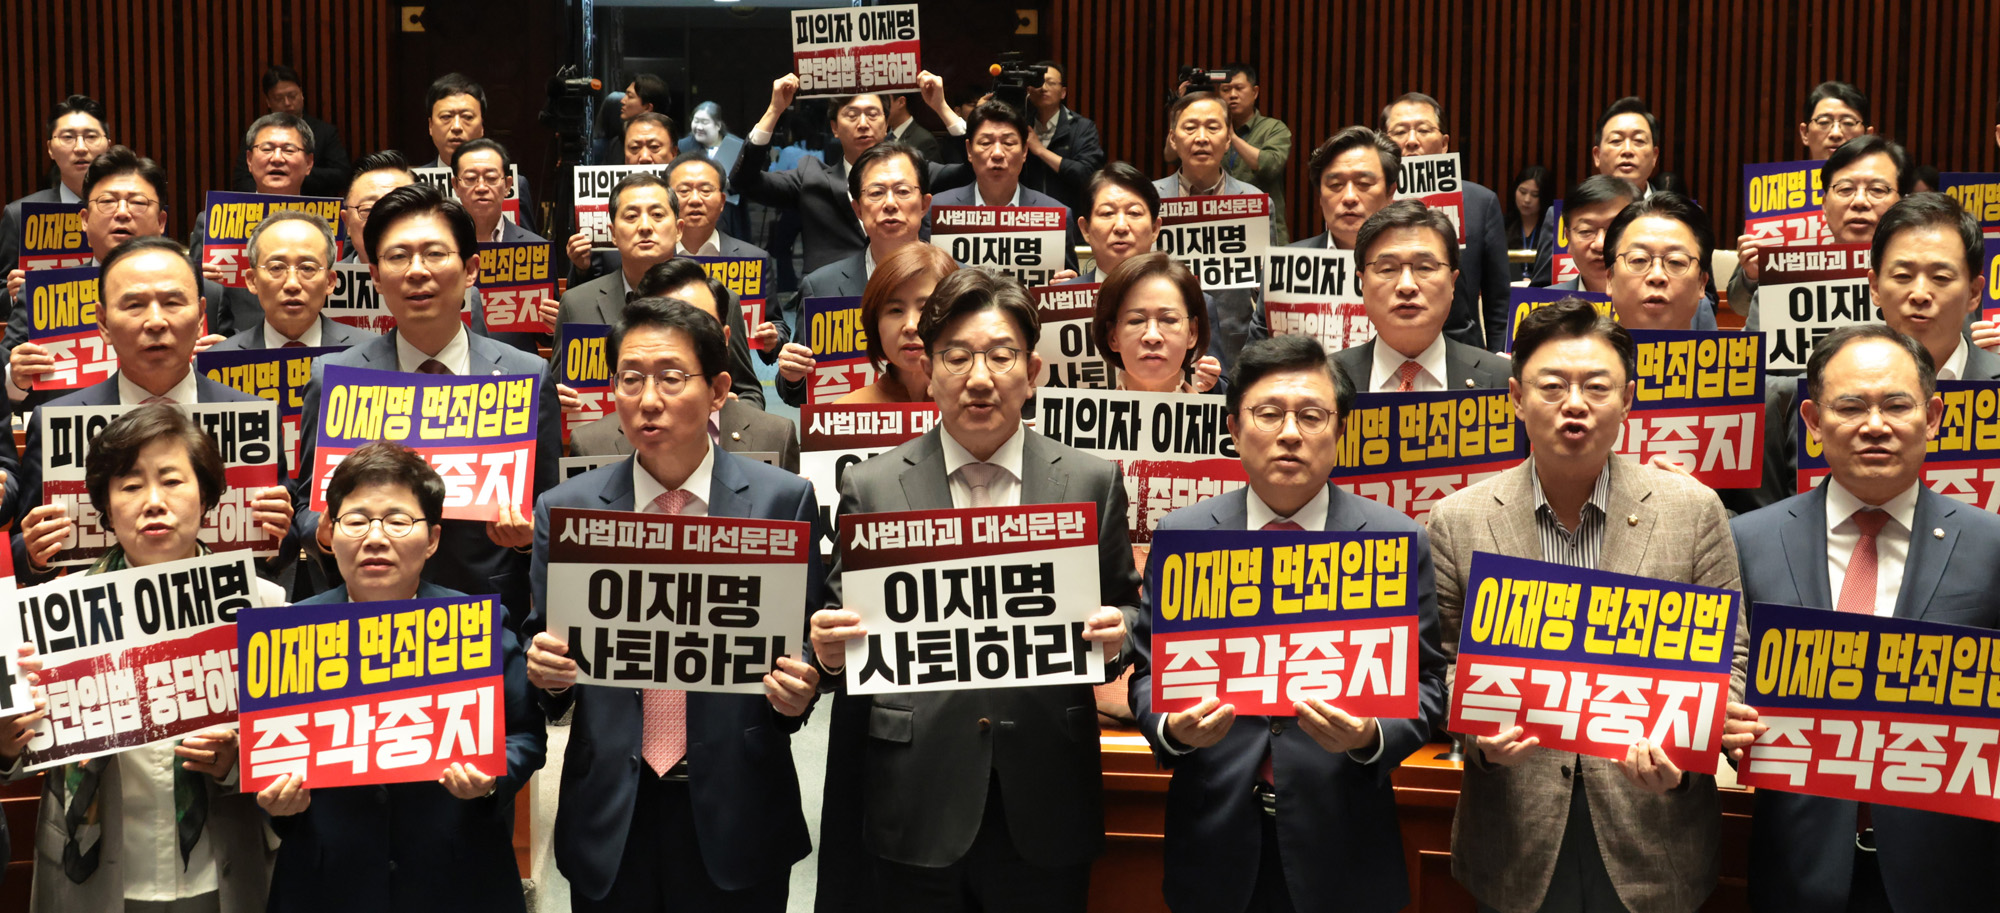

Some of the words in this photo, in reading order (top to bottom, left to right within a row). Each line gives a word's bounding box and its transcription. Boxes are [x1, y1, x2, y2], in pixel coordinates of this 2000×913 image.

[796, 13, 853, 44] 피의자
[859, 9, 915, 41] 이재명
[798, 55, 856, 90] 방탄입법
[860, 52, 917, 86] 중단하라
[1397, 158, 1457, 194] 이재명
[1749, 170, 1806, 213] 이재명
[208, 202, 264, 239] 이재명
[936, 210, 996, 227] 사법파괴
[1001, 211, 1060, 228] 대선문란
[1202, 198, 1263, 216] 대선문란
[24, 213, 83, 250] 이재명
[952, 237, 1042, 266] 이재명
[1156, 224, 1247, 256] 이재명
[479, 244, 550, 284] 면죄입법
[1270, 255, 1346, 296] 피의자
[1765, 250, 1847, 272] 사법파괴
[33, 278, 99, 331] 이재명
[480, 288, 549, 326] 중지
[1788, 284, 1886, 322] 이재
[1637, 336, 1758, 401] 면죄입법
[325, 384, 416, 440] 이재명
[420, 378, 534, 440] 면죄입법
[809, 411, 903, 435] 사법파괴
[1043, 397, 1141, 451] 피의자
[1398, 393, 1516, 463] 면죄입법
[560, 518, 674, 550] 사법파괴
[683, 524, 798, 556] 대선문란
[851, 517, 963, 550] 사법파괴
[972, 511, 1085, 543] 대선문란
[134, 560, 253, 635] 이재명
[588, 569, 761, 628] 이재명
[884, 562, 1056, 623] 이재명
[1160, 547, 1263, 621] 이재명
[1272, 537, 1409, 615] 면죄입법
[1470, 577, 1582, 651] 이재명
[1583, 586, 1731, 663] 면죄입법
[247, 619, 349, 698] 이재명
[358, 599, 492, 685] 면죄입법
[567, 626, 791, 685] 사퇴하라
[859, 622, 1092, 686] 사퇴하라
[1161, 626, 1409, 704] 즉각중지
[1755, 628, 1869, 700] 이재명
[1460, 663, 1719, 751] 즉각중지
[250, 685, 494, 782] 즉각중지
[1750, 716, 2000, 799] 즉각중지
